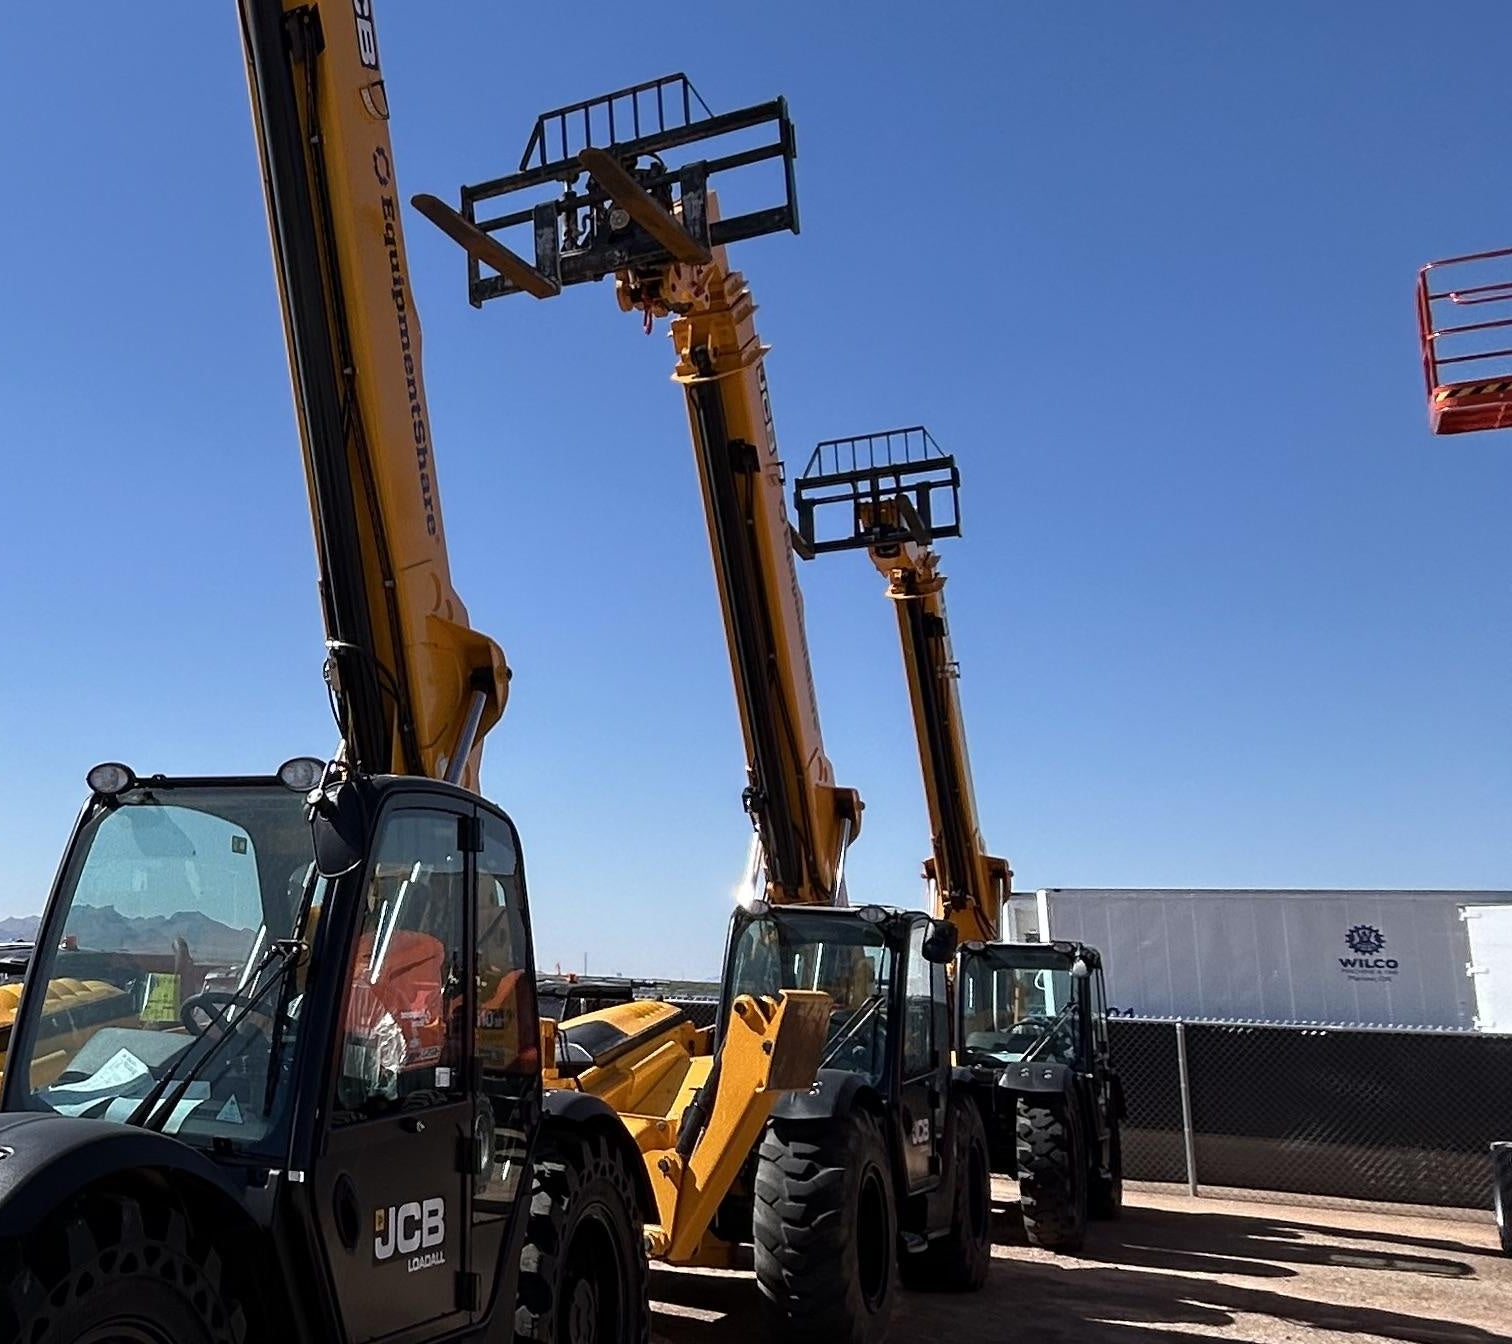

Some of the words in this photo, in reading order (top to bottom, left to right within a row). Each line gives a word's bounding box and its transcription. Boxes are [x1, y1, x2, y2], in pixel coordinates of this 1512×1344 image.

[381, 194, 438, 537] EquipmentShare
[1338, 958, 1399, 969] WILCO
[374, 1197, 445, 1260] JCB
[407, 1251, 446, 1273] LOADALL
